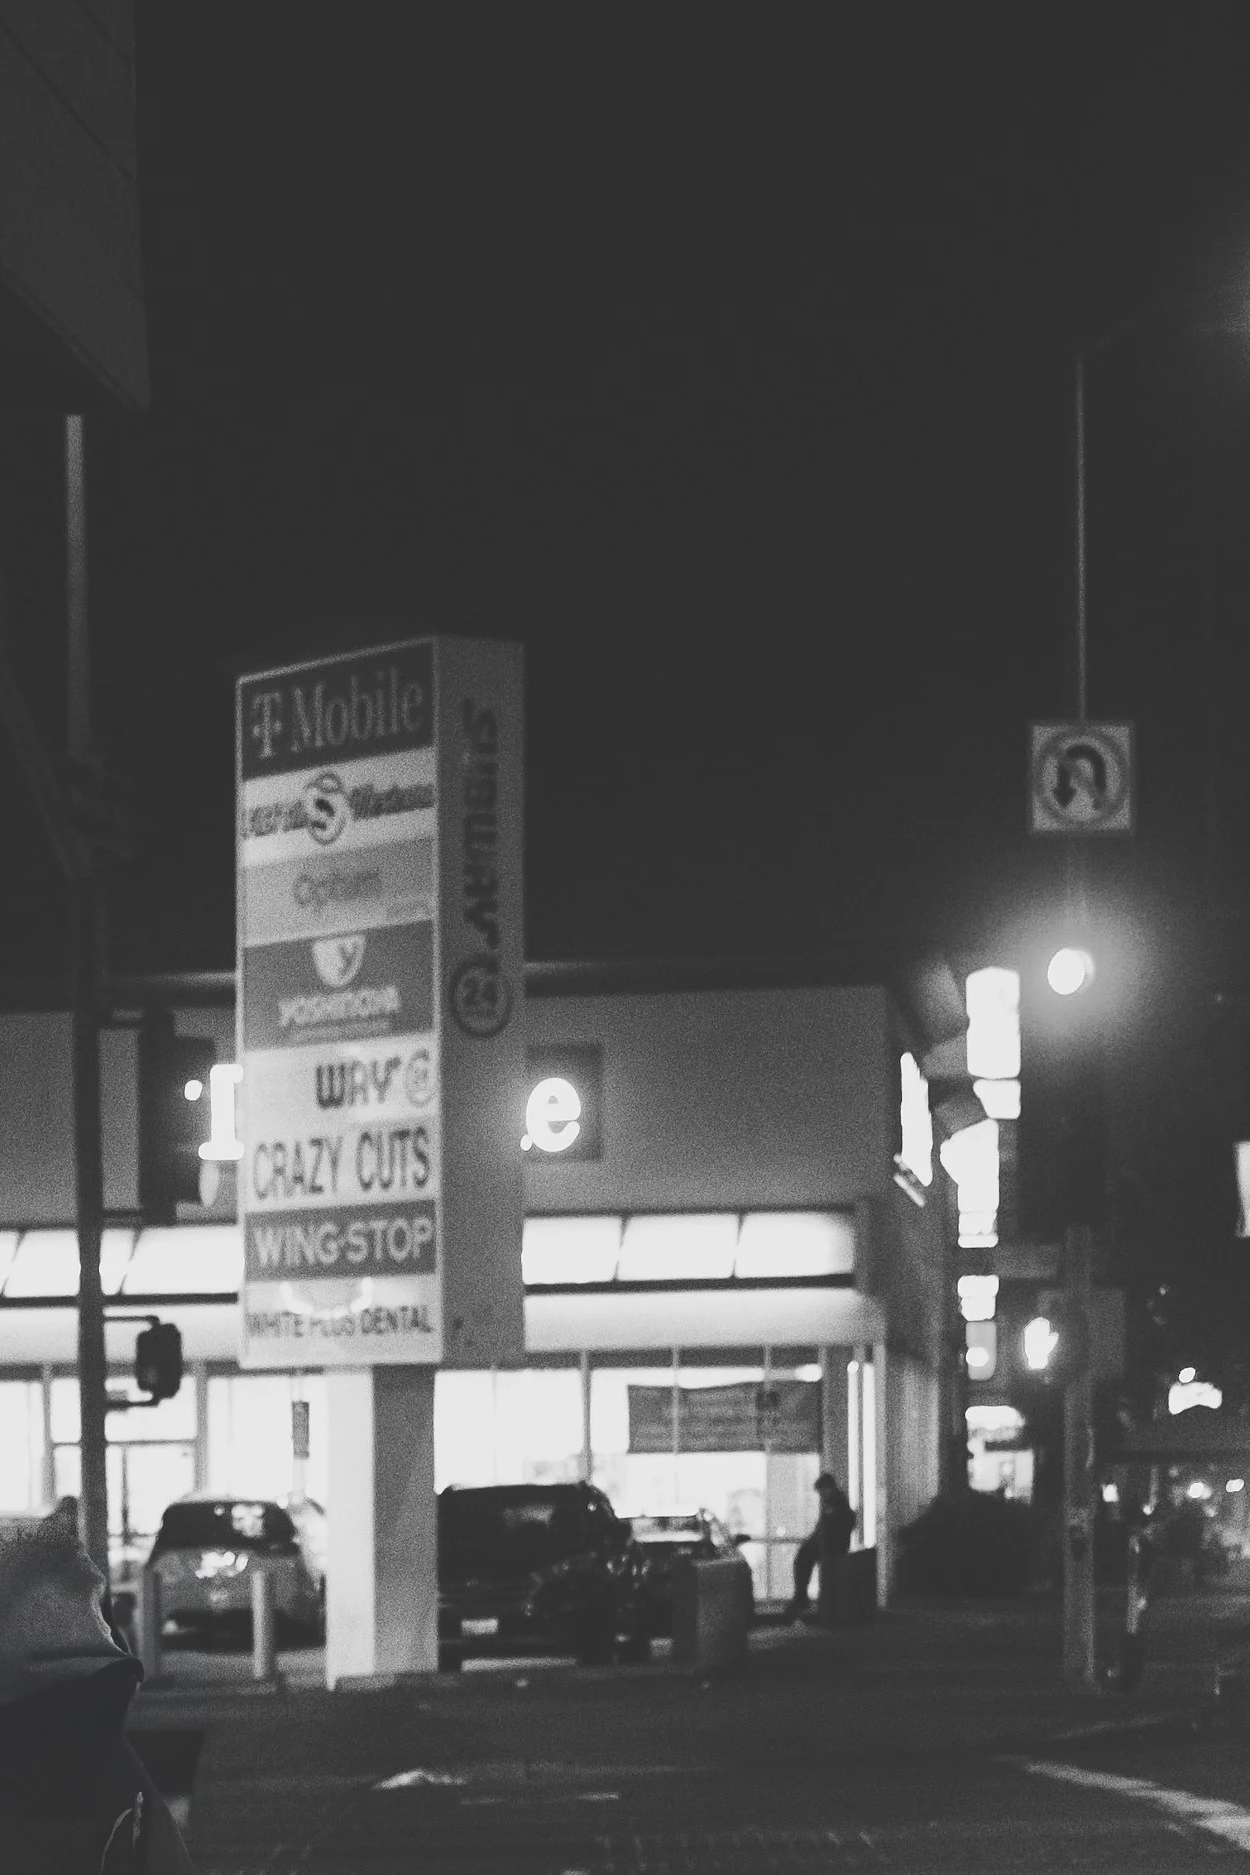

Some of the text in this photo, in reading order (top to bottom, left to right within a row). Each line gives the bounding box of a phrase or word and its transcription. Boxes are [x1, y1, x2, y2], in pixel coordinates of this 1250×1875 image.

[252, 1125, 431, 1202] CRAZY CUTS
[359, 1303, 434, 1336] DENTAL
